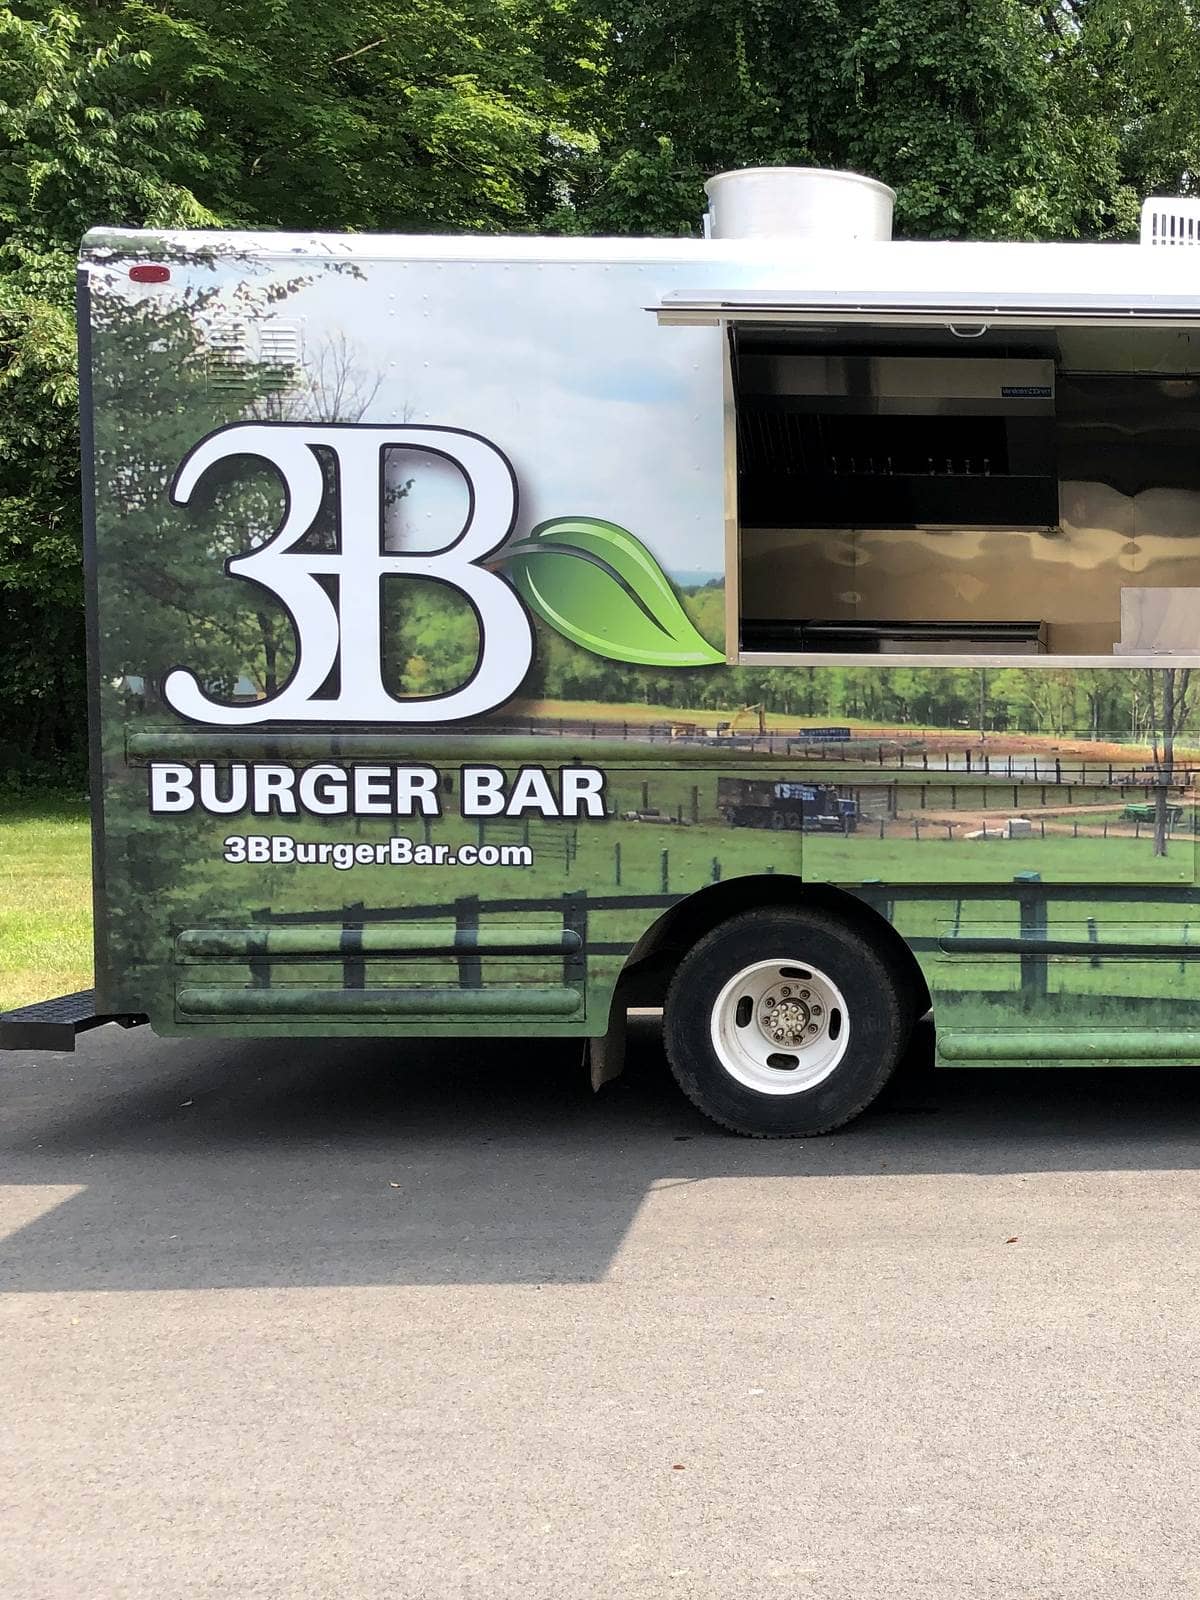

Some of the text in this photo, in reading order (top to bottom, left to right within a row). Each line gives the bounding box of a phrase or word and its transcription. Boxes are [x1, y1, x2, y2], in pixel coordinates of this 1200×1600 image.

[162, 420, 536, 725] 3B
[149, 761, 607, 820] BURGER BAR
[223, 835, 533, 869] 3BBurgerBar.com
